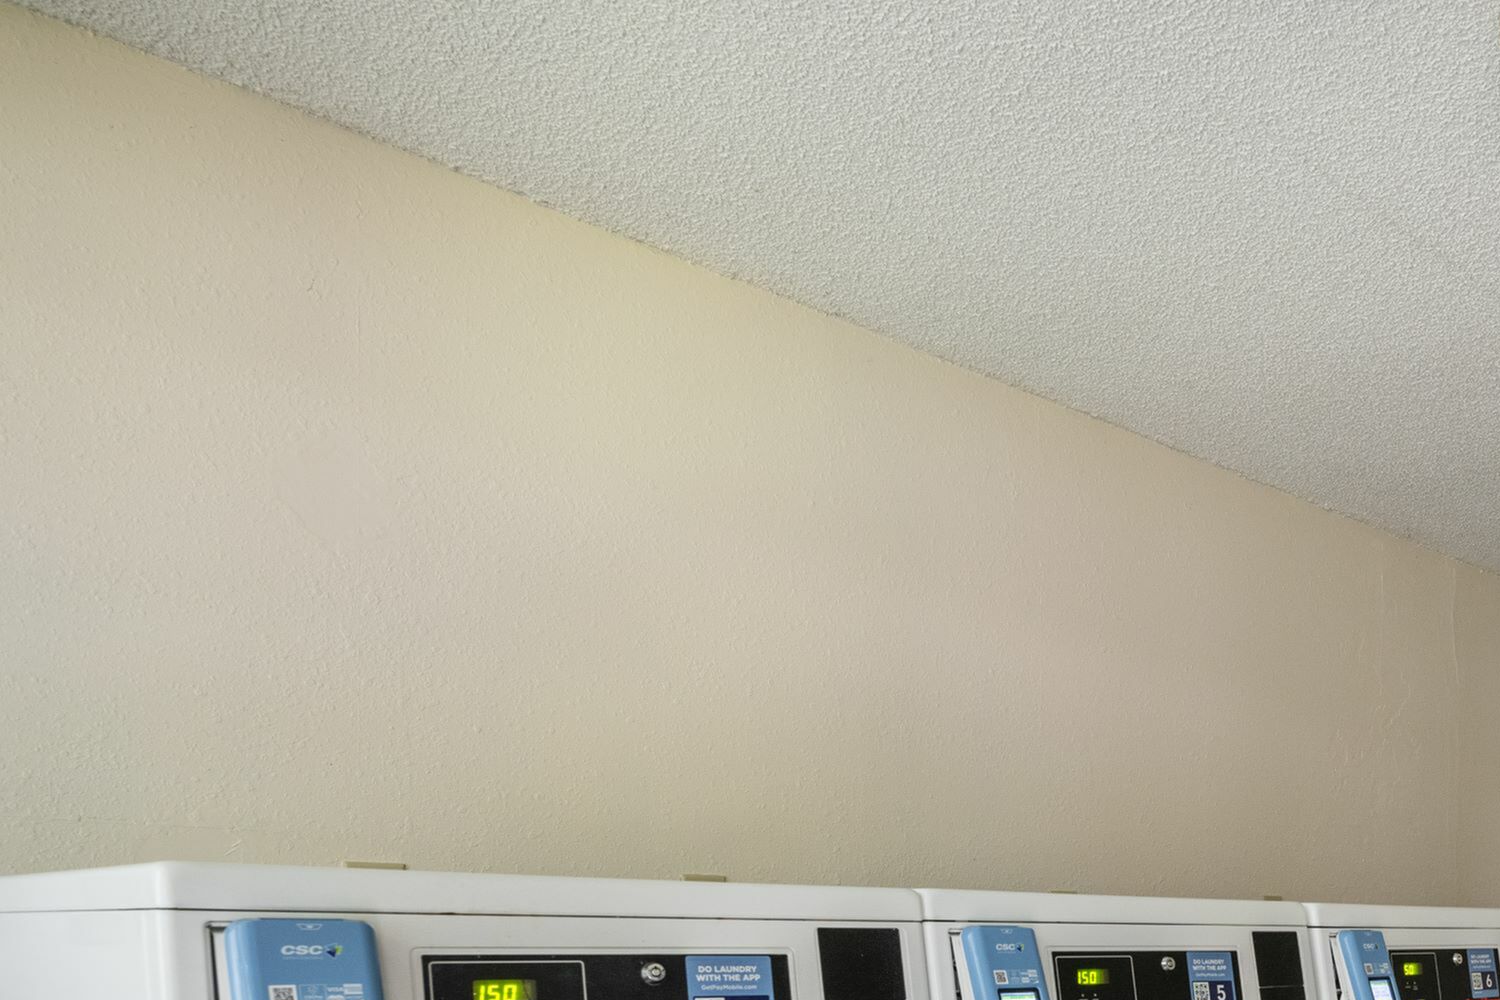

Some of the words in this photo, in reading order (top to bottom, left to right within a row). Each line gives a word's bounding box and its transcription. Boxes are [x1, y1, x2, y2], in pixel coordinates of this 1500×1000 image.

[281, 945, 323, 955] CSC
[996, 943, 1016, 951] CSC
[696, 974, 721, 982] WITH
[722, 974, 741, 982] THE
[743, 974, 761, 982] APP
[1077, 972, 1097, 985] 150
[1486, 974, 1492, 988] 6
